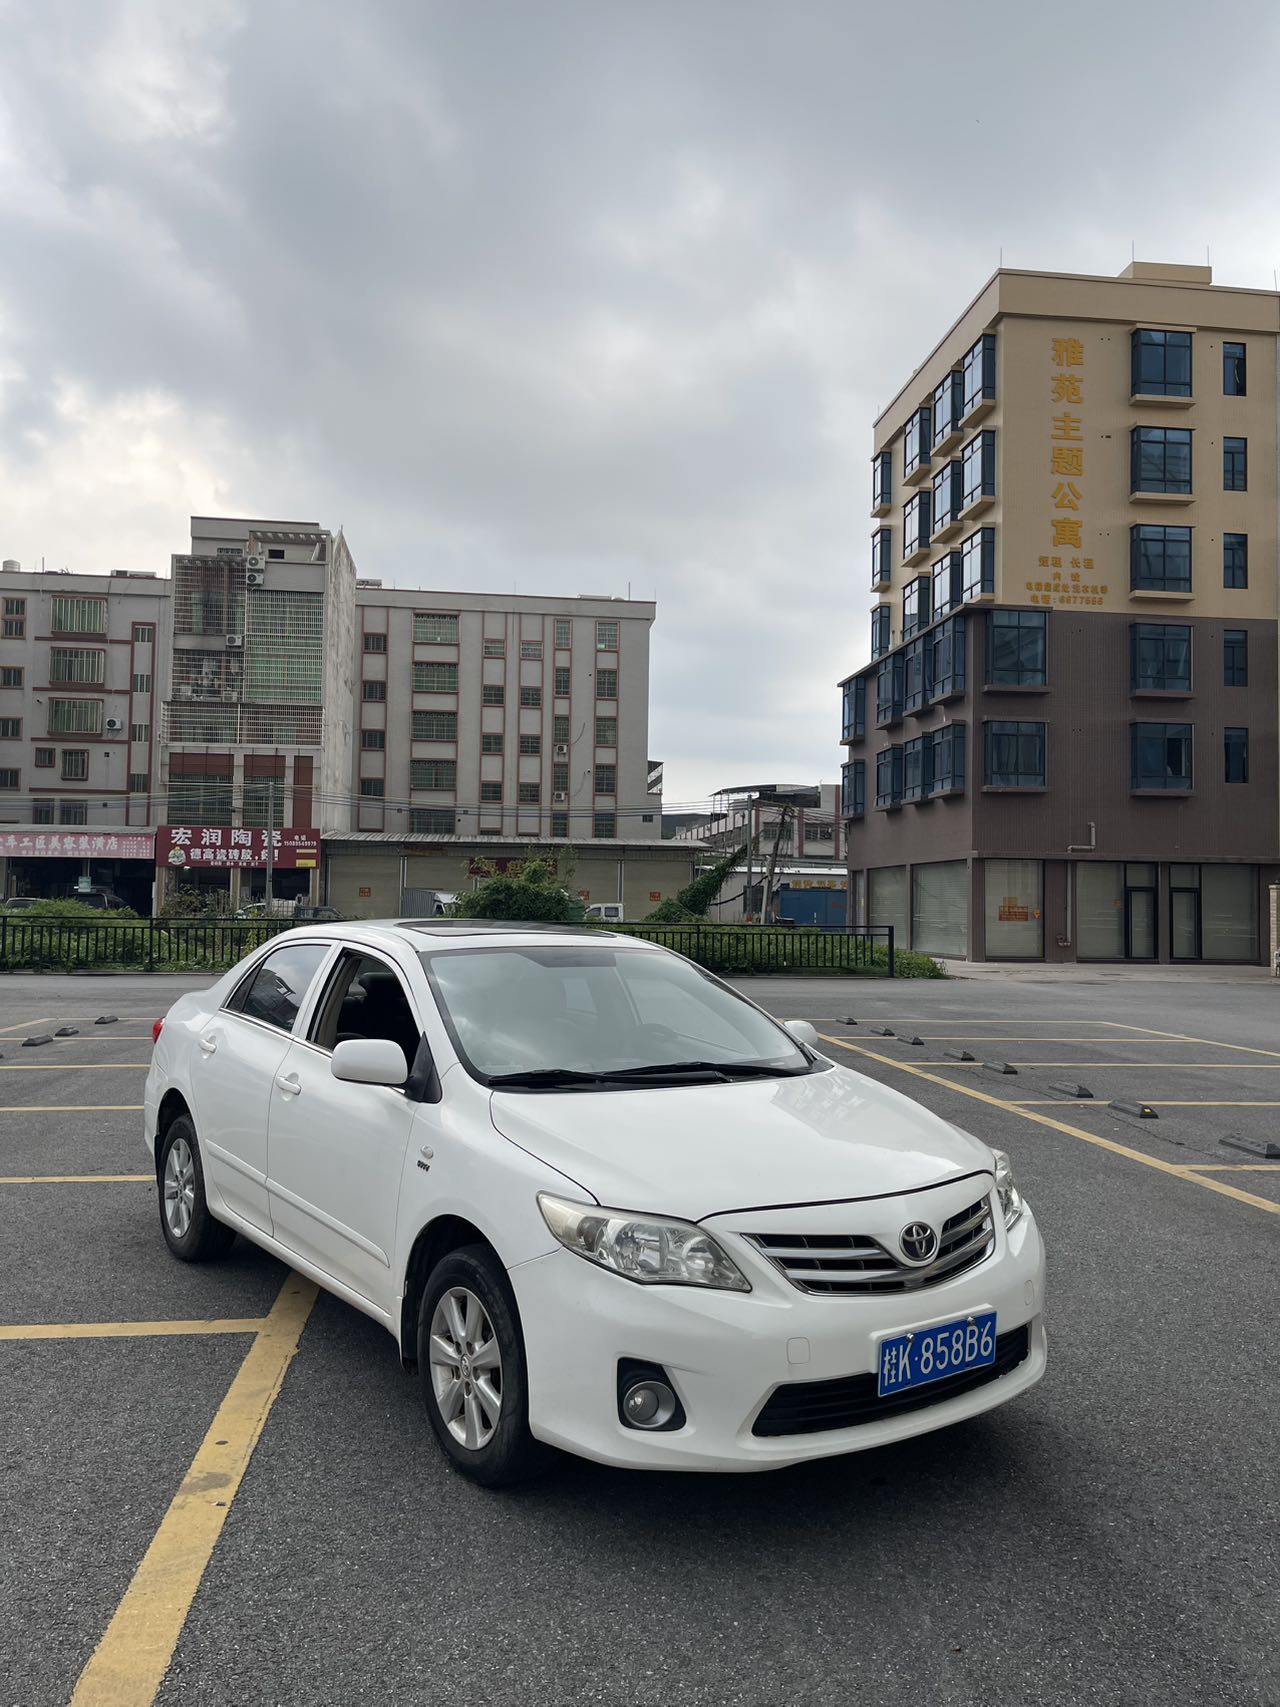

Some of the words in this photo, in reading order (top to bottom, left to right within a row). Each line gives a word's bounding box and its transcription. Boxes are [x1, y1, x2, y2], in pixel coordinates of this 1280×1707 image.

[1051, 337, 1085, 549] 雅苑主题公寓
[0, 834, 118, 850] 车工匠美容装潢店
[170, 827, 282, 847] 宏润陶瓷
[883, 1321, 992, 1387] 桂K·858B6
